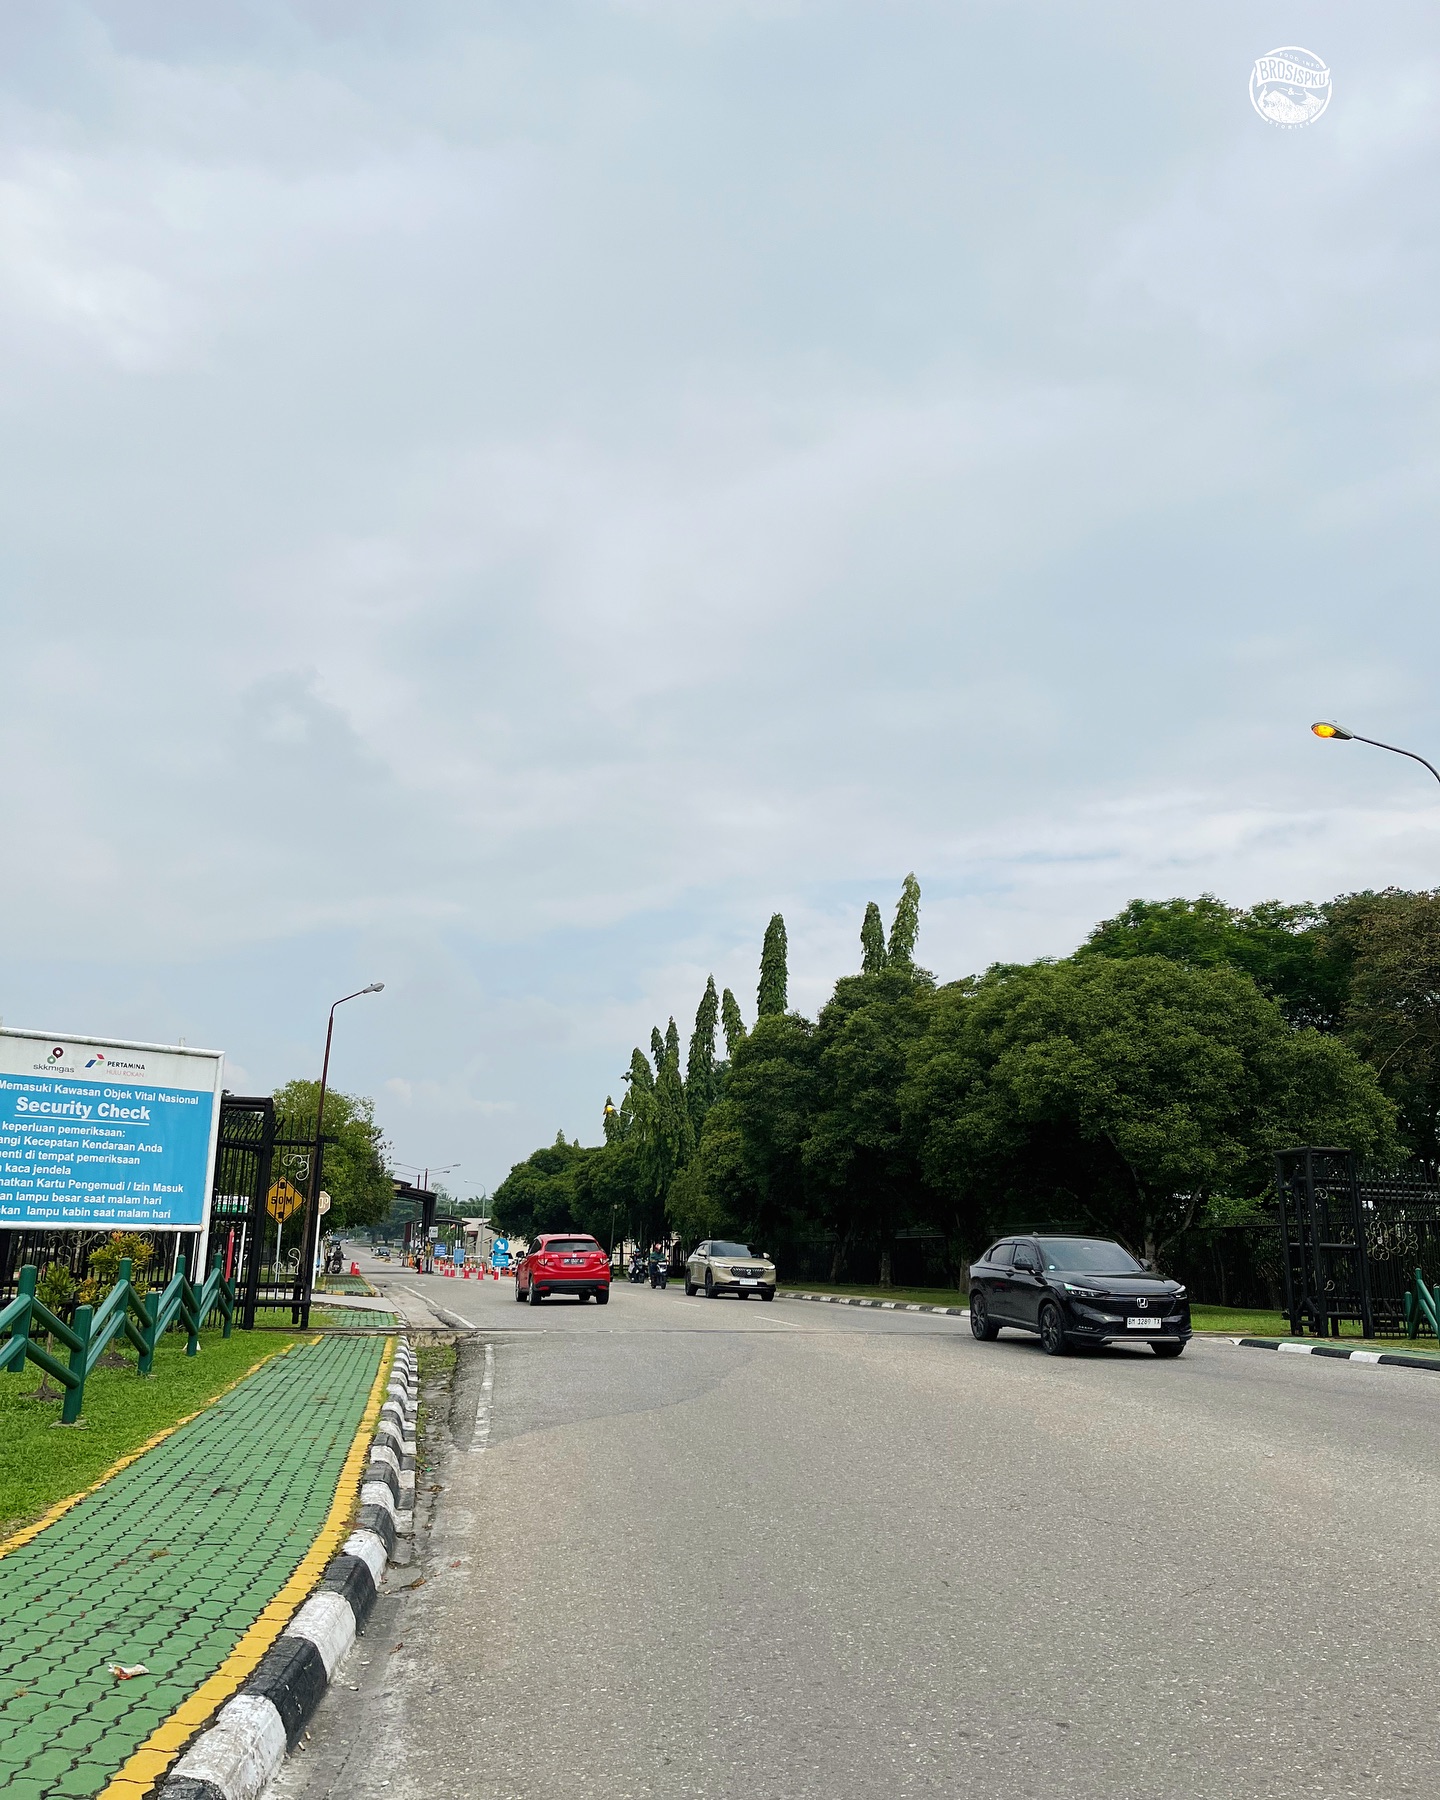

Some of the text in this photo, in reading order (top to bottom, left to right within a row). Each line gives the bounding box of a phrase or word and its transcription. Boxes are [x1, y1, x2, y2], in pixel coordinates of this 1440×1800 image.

[33, 1063, 75, 1074] skkmigas
[107, 1061, 145, 1070] PERTAMINA
[0, 1080, 199, 1105] Memasuki Kawasan Objek Vital Nasional
[16, 1096, 151, 1120] Security Check
[2, 1120, 126, 1138] keperluan pemeriksaan:
[23, 1135, 79, 1149] Kecepatan
[82, 1139, 136, 1151] Kendaraan
[137, 1142, 163, 1153] Anda
[25, 1150, 36, 1160] di
[38, 1151, 75, 1163] tempat
[76, 1153, 141, 1165] pemeriksaan
[5, 1162, 31, 1173] kaca
[32, 1163, 72, 1176] jendela
[36, 1177, 66, 1189] Kartu
[68, 1179, 125, 1192] Pengemudi
[133, 1182, 151, 1192] Izin
[152, 1183, 184, 1193] Masuk
[16, 1191, 49, 1203] lampu
[52, 1192, 82, 1203] besar
[83, 1194, 105, 1204] saat
[107, 1195, 141, 1205] malam
[143, 1195, 162, 1206] hari
[26, 1205, 60, 1218] lampu
[62, 1206, 91, 1217] kabin
[93, 1208, 115, 1218] saat
[117, 1208, 150, 1219] malam
[152, 1209, 172, 1219] hari
